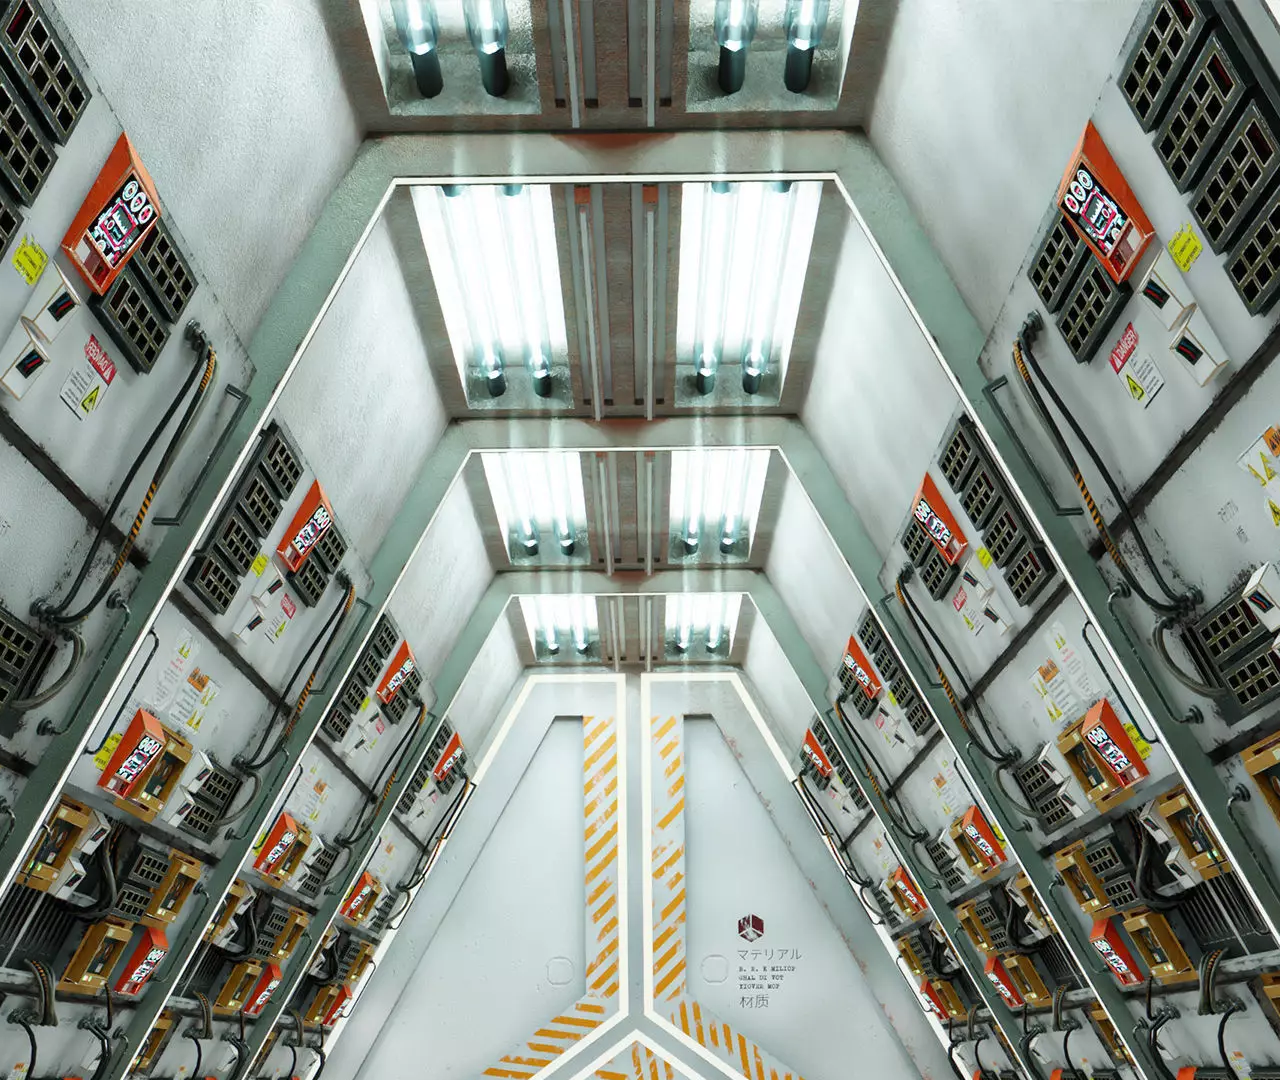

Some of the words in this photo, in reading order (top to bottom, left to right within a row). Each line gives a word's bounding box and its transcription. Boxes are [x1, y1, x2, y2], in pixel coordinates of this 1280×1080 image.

[1114, 329, 1137, 360] DANGER
[737, 948, 802, 961] マテリアル
[739, 993, 770, 1009] 材质
